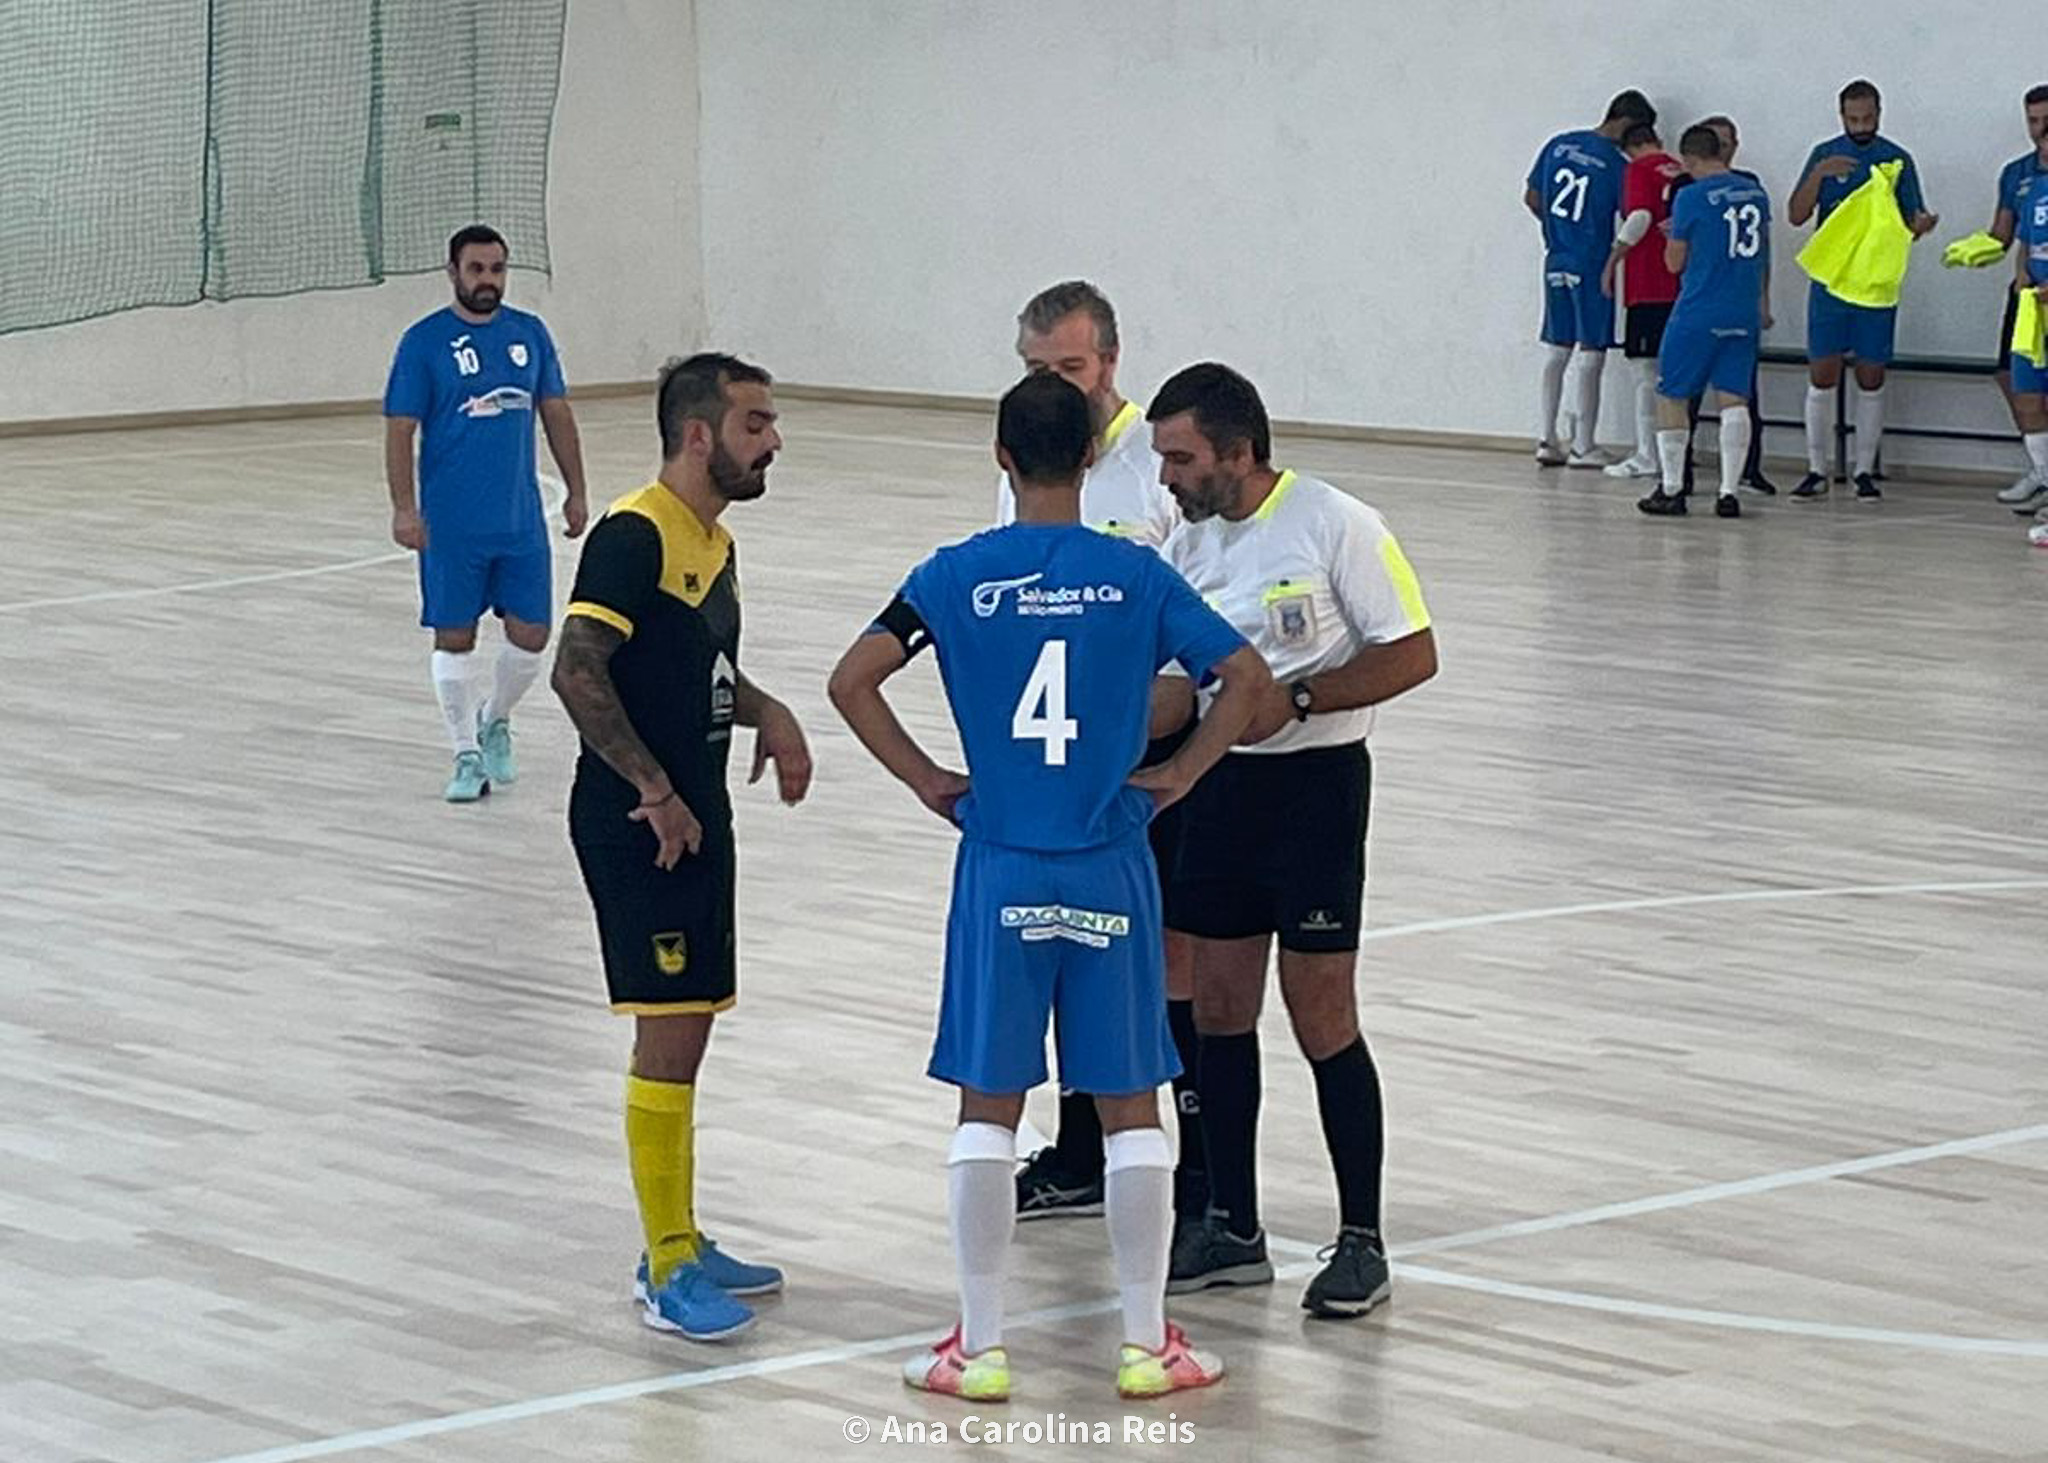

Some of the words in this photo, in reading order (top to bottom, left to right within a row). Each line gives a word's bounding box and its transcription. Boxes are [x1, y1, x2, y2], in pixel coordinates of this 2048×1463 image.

[1551, 168, 1589, 222] 21
[1723, 204, 1760, 258] 13
[454, 347, 480, 376] 10
[1012, 639, 1078, 766] 4
